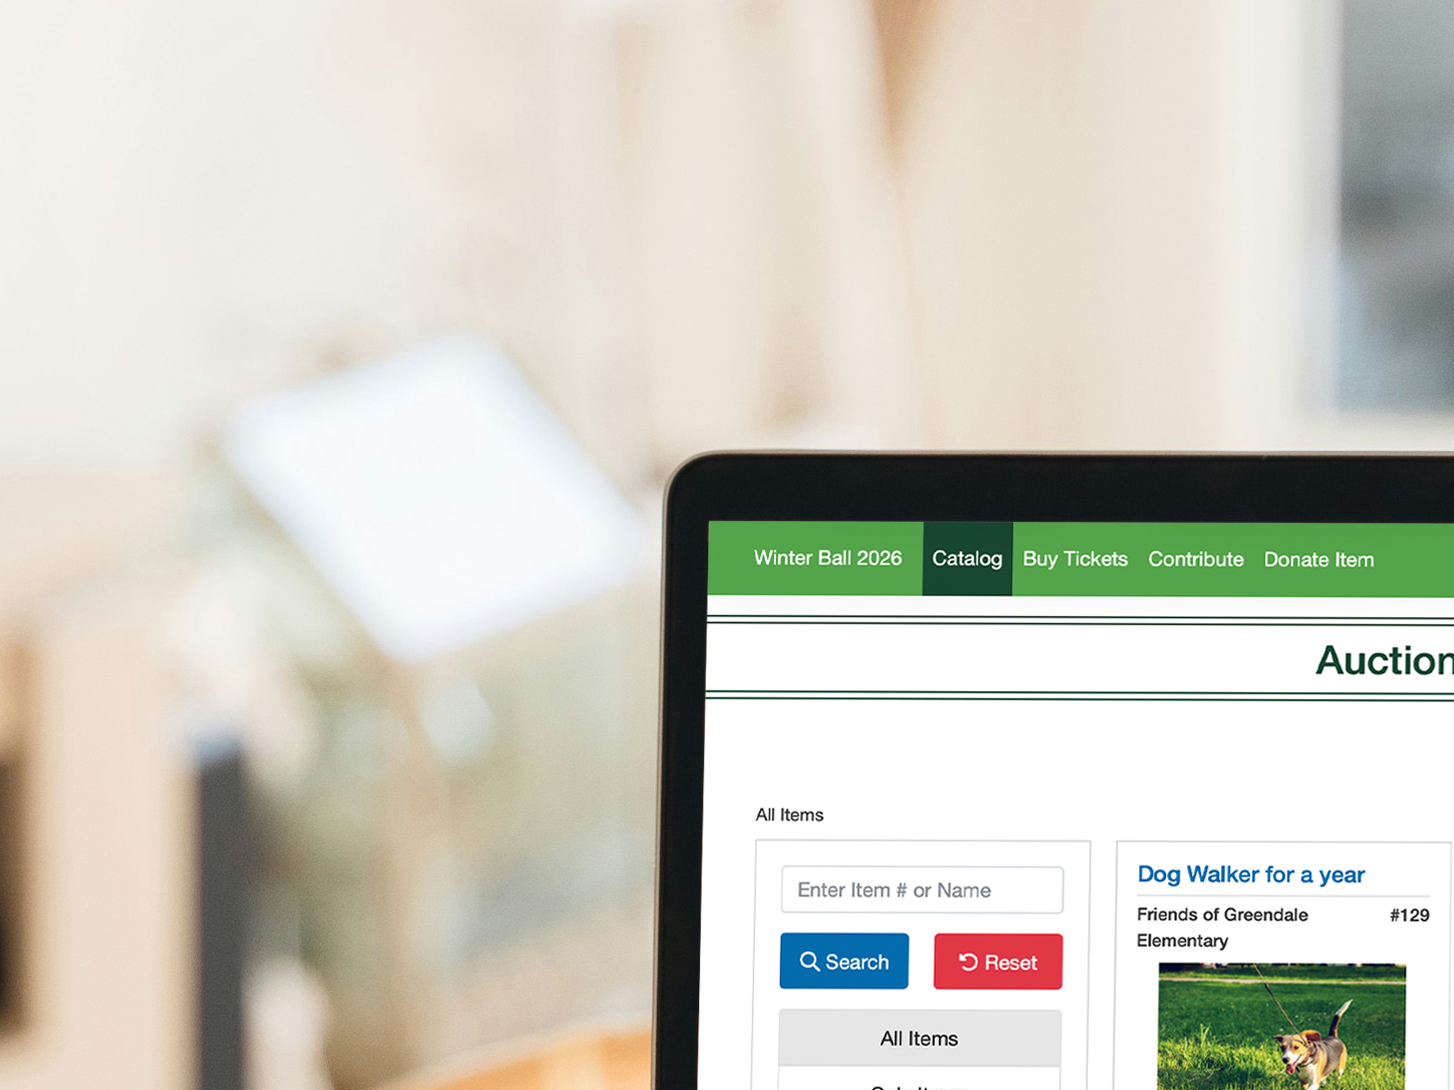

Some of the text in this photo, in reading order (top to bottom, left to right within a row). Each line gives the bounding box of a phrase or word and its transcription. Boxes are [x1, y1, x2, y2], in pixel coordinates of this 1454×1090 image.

[754, 550, 902, 565] Winter Ball 2026
[933, 550, 1002, 570] Catalog
[1024, 551, 1128, 570] Buy Tickets
[1149, 551, 1244, 567] Contribute
[1265, 551, 1374, 567] Donate Item
[756, 808, 824, 822] All Items
[1139, 865, 1366, 887] Dog Walker for a year
[798, 882, 991, 898] Enter Item # or Name
[1138, 907, 1308, 921] Friends of Greendale
[1390, 908, 1430, 922] #129
[1138, 934, 1228, 951] Elementary
[826, 954, 889, 970] Search
[986, 955, 1037, 970] Reset
[881, 1031, 958, 1046] All Items
